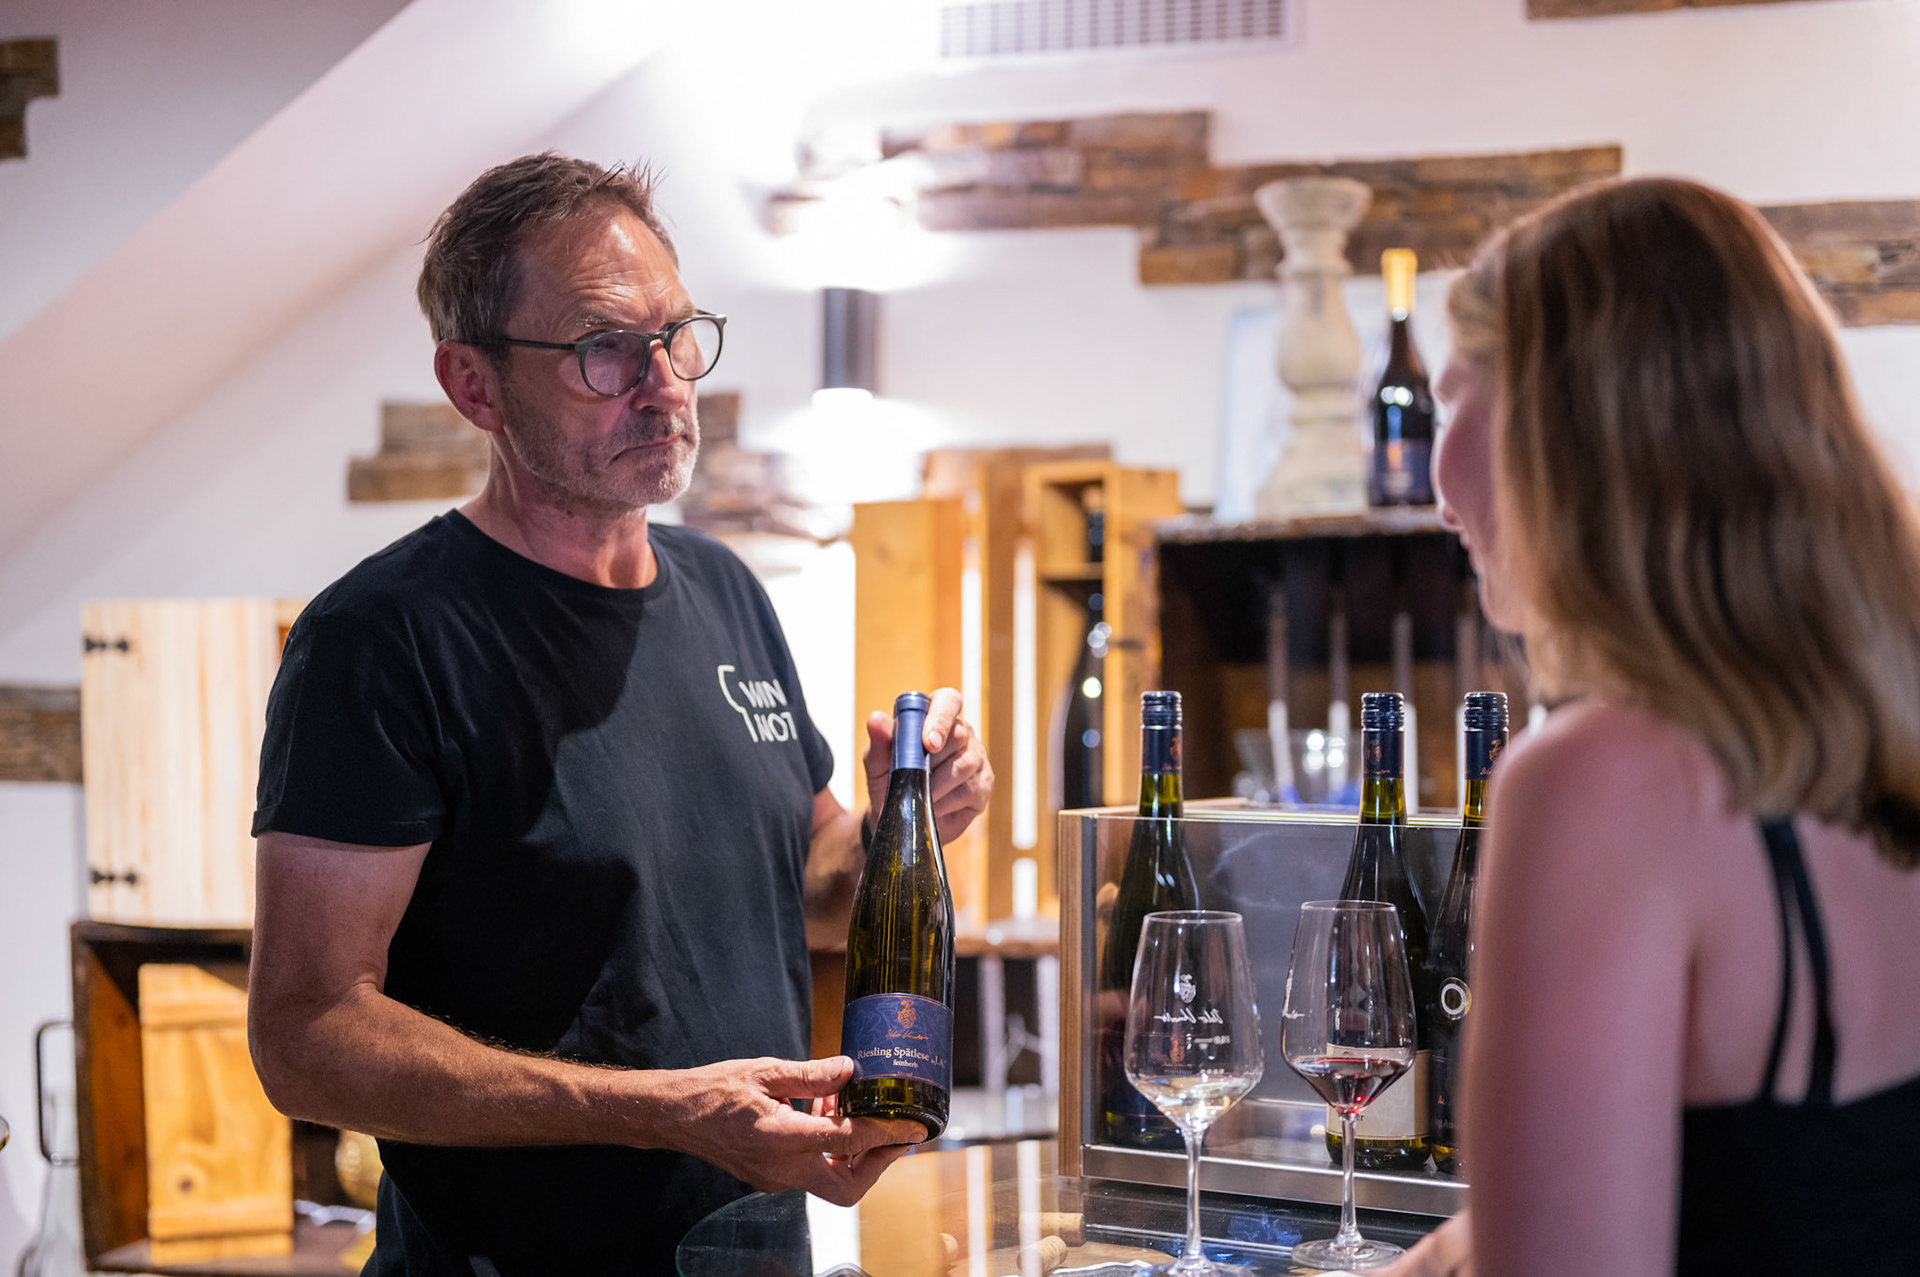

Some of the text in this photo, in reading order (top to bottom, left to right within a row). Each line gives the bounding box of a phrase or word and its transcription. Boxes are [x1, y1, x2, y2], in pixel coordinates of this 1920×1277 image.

[738, 679, 787, 708] WIN
[753, 711, 798, 742] NOT
[857, 1047, 892, 1059] Riesling
[894, 1046, 930, 1061] Spätlese
[893, 1059, 918, 1068] feinherb
